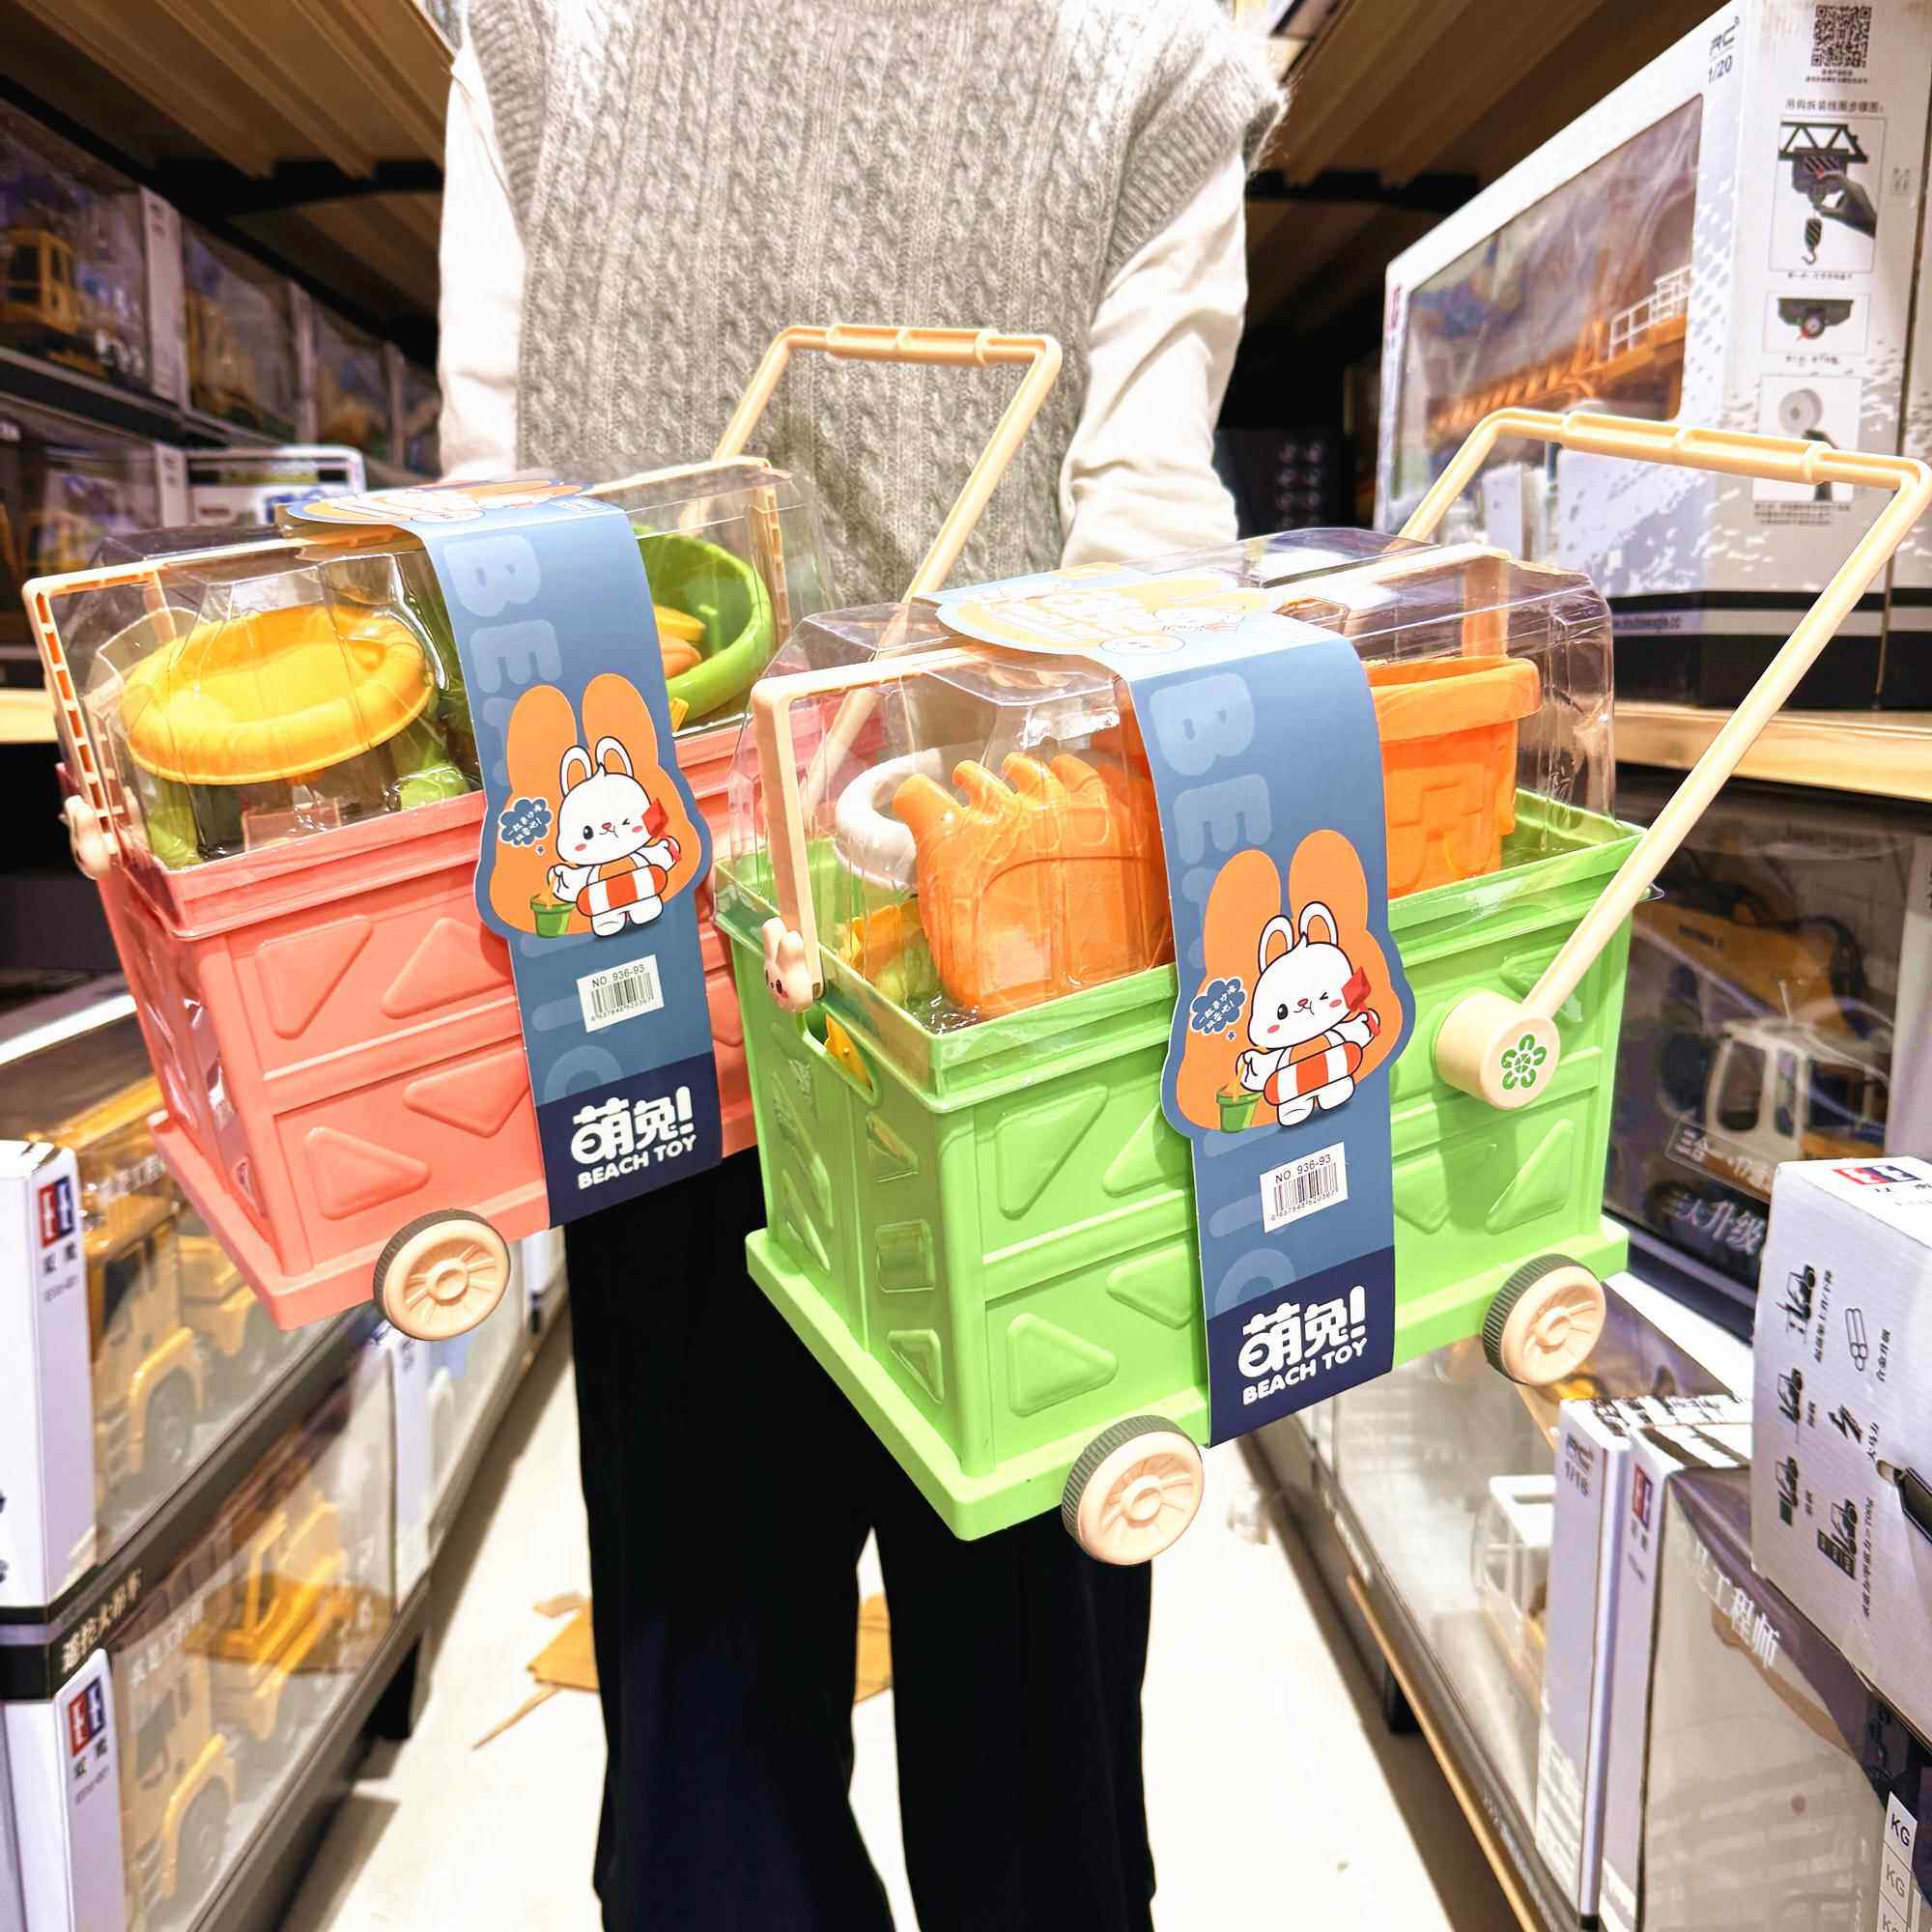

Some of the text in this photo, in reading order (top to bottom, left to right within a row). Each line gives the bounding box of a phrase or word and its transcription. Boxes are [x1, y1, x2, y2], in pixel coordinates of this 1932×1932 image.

[612, 964, 645, 981] 936-93
[578, 1134, 696, 1190] BEACH TOY
[1297, 1154, 1331, 1175] 936-93
[1242, 1337, 1368, 1406] BEACH TOY
[1890, 1813, 1911, 1847] KG
[1887, 1863, 1906, 1898] KG
